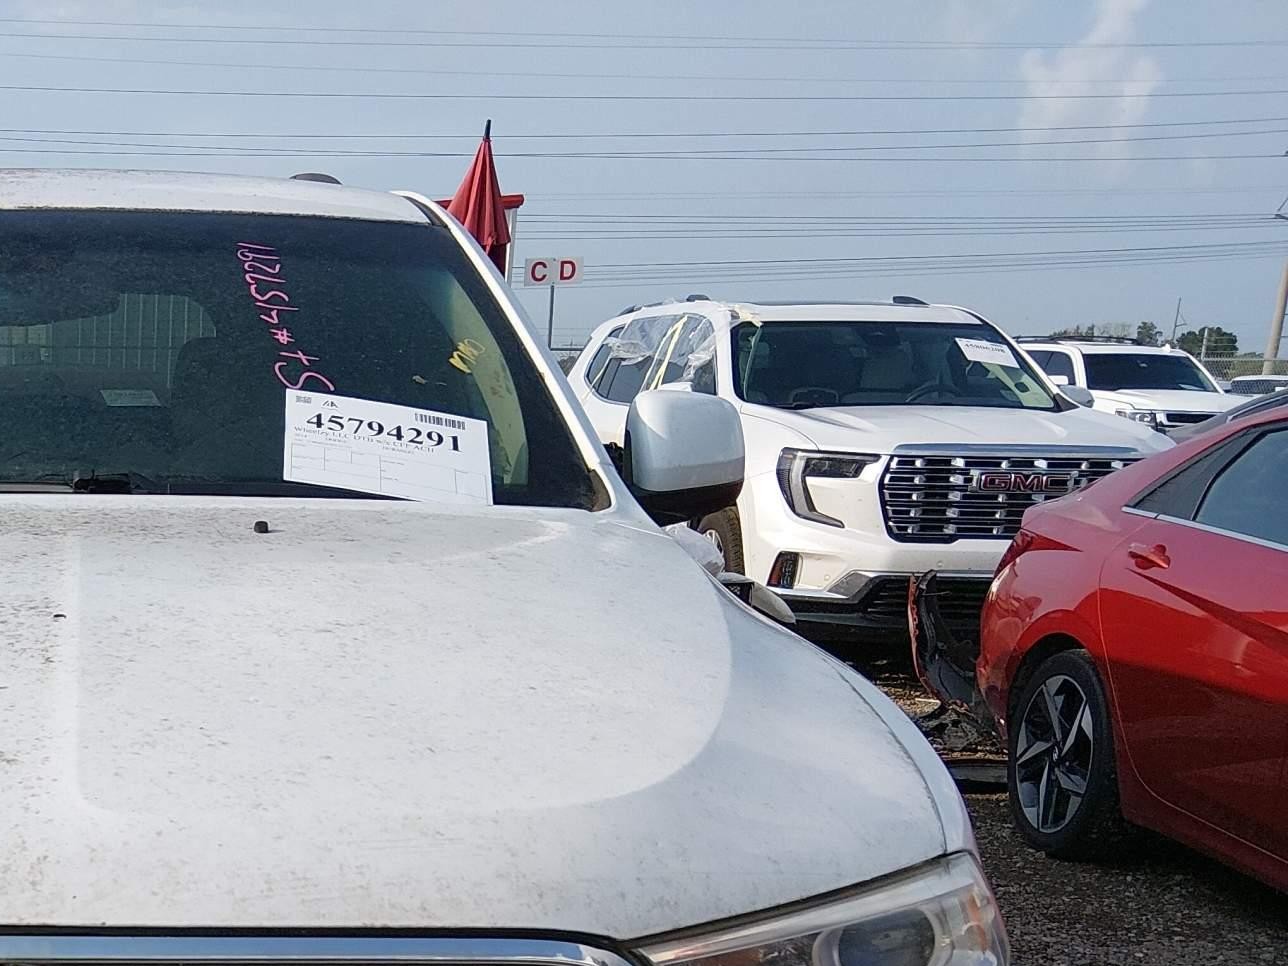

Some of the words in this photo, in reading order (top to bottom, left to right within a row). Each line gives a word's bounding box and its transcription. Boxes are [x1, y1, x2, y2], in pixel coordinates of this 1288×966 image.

[530, 261, 548, 282] C
[559, 260, 576, 281] D
[306, 412, 464, 453] 45794291
[980, 473, 1071, 492] GMC
